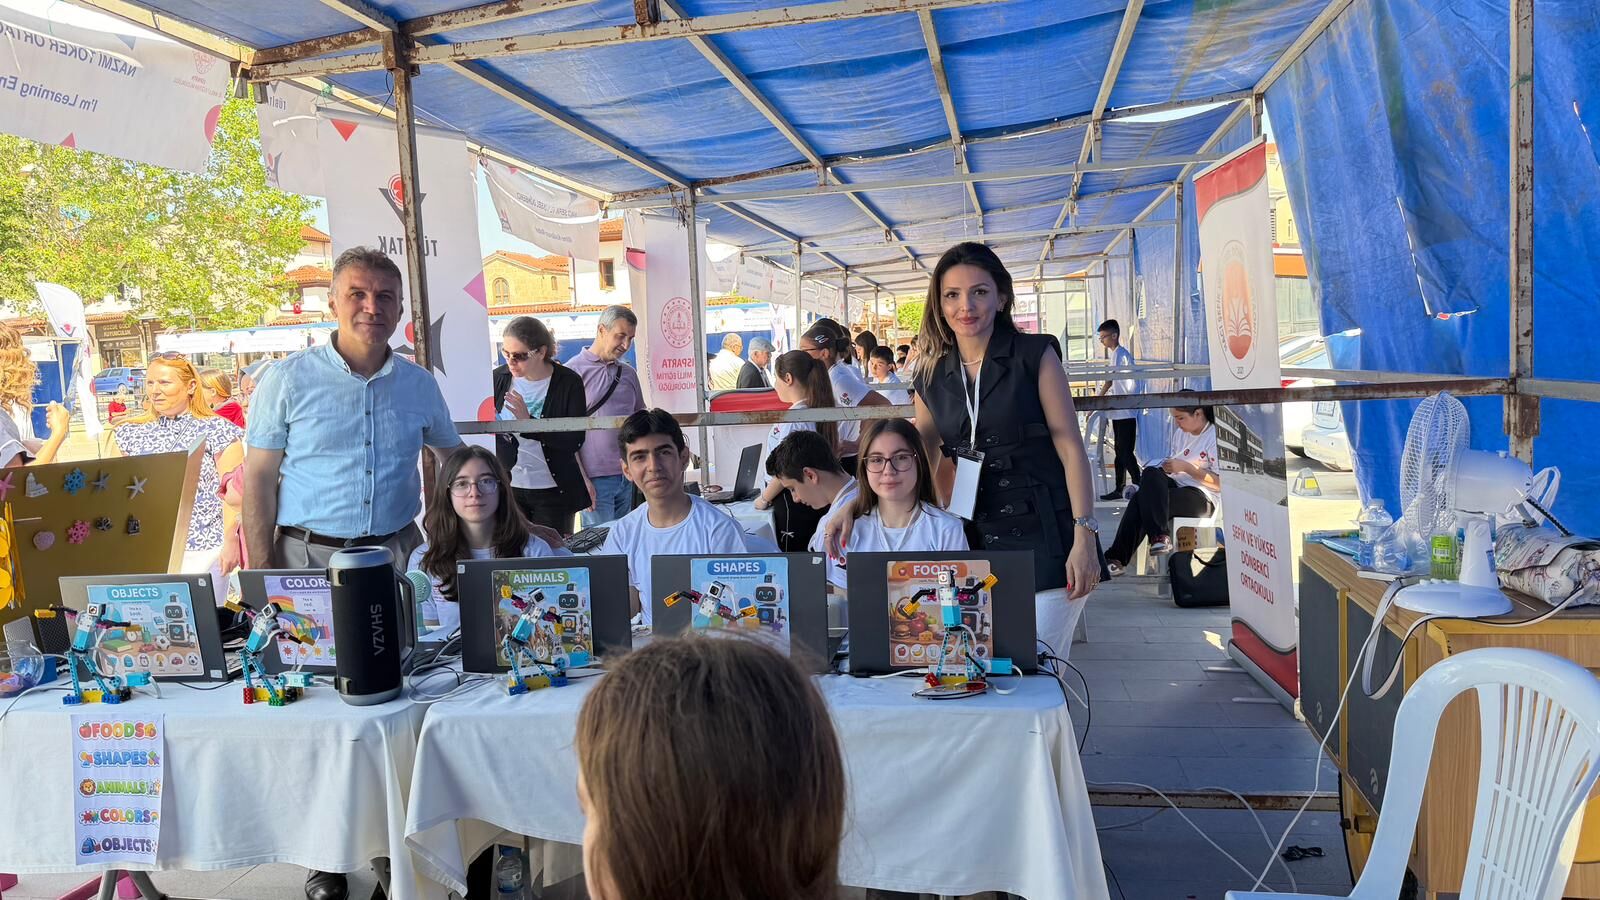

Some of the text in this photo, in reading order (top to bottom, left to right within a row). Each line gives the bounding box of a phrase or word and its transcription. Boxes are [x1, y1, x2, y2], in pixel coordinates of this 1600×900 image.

[1244, 508, 1258, 527] HACI
[1232, 524, 1278, 560] ŞEFİK VE YÜKSEL
[713, 562, 760, 573] SHAPES
[513, 572, 565, 584] ANIMALS
[111, 587, 159, 599] OBJECTS
[1240, 572, 1274, 605] ORTAOKULU
[370, 604, 385, 656] SHAZA
[91, 722, 145, 738] FOODS
[93, 751, 148, 766] SHAPES
[96, 780, 146, 795] ANIMALS
[100, 808, 150, 823] COLORS
[101, 837, 153, 852] OBJECTS
